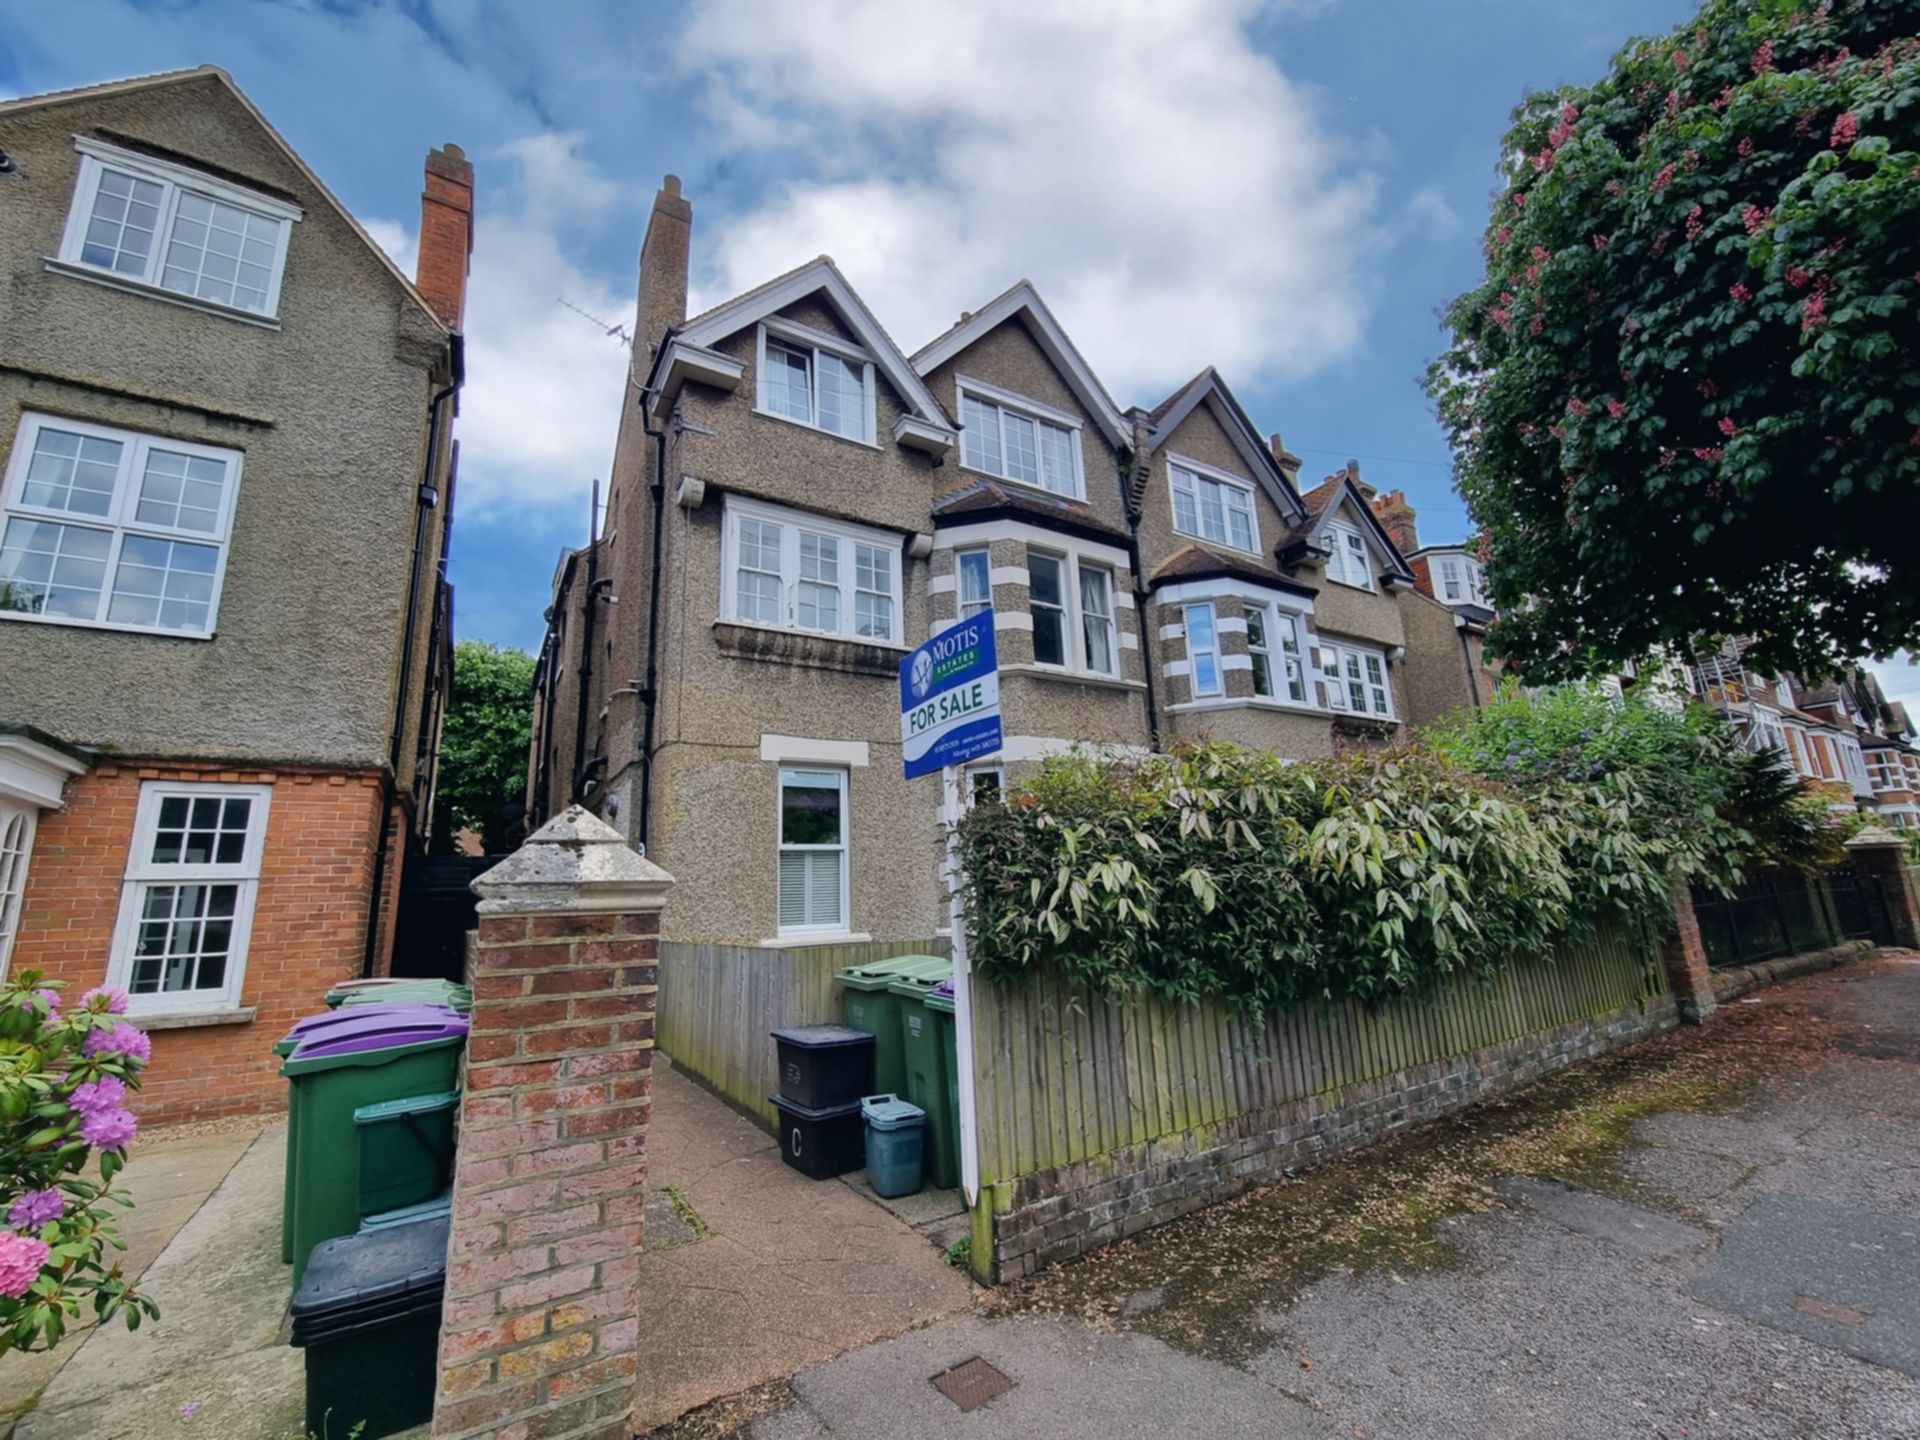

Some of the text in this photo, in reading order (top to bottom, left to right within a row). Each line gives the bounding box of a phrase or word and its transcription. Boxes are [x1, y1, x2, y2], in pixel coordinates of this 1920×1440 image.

[933, 625, 979, 664] MOTIS
[937, 651, 974, 674] ESTATES
[910, 683, 983, 734] FOR SALE
[791, 1127, 802, 1157] C
